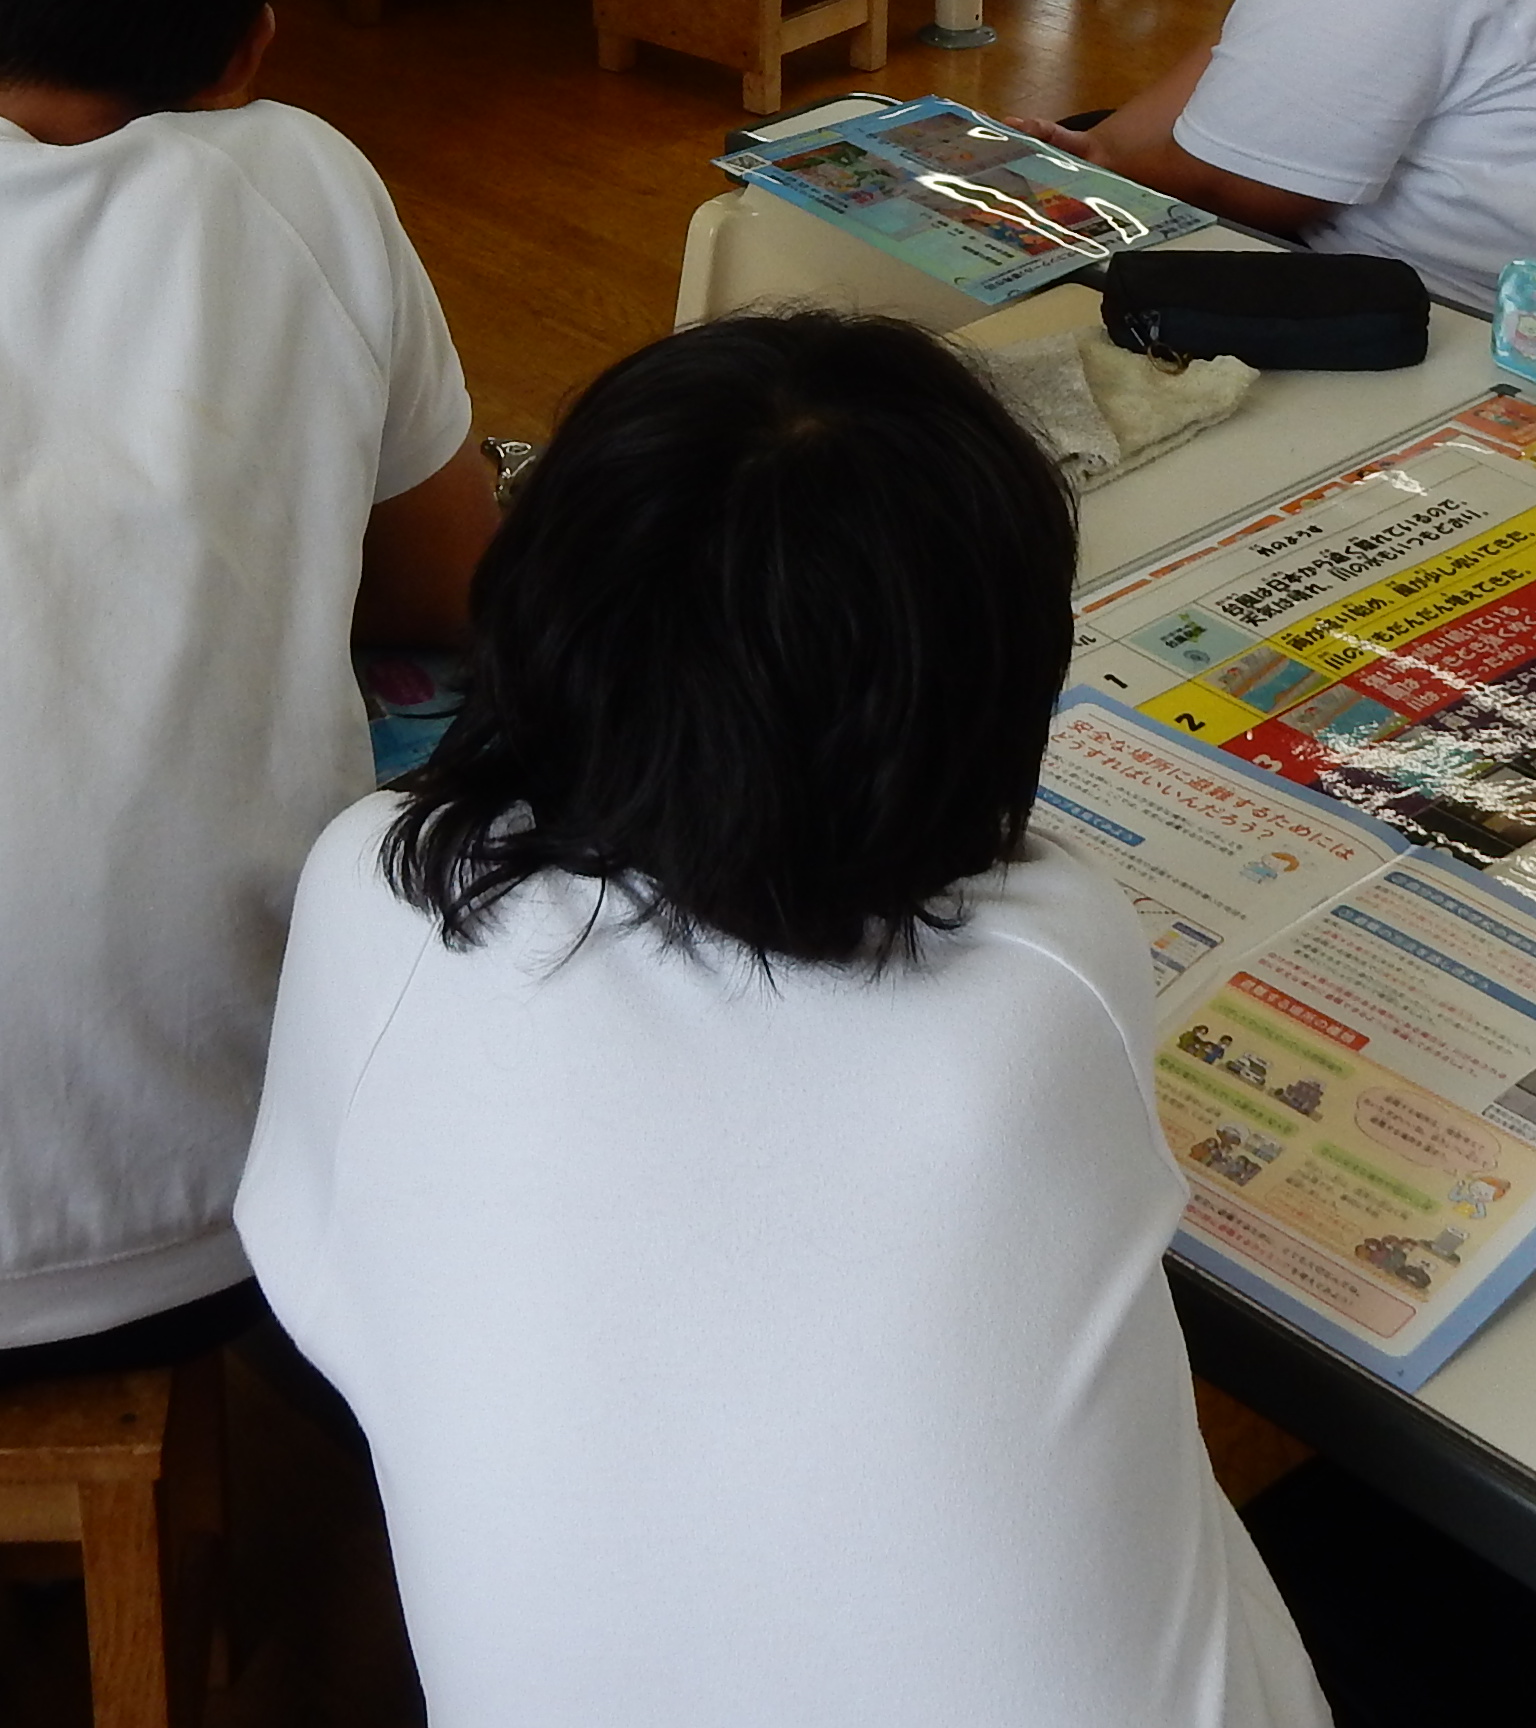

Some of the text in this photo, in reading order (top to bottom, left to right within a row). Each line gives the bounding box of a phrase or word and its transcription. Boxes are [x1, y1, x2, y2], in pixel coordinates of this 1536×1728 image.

[1103, 673, 1128, 689] 1
[1174, 713, 1205, 732] 2
[1067, 719, 1356, 861] 安全な場所に避難するためには
